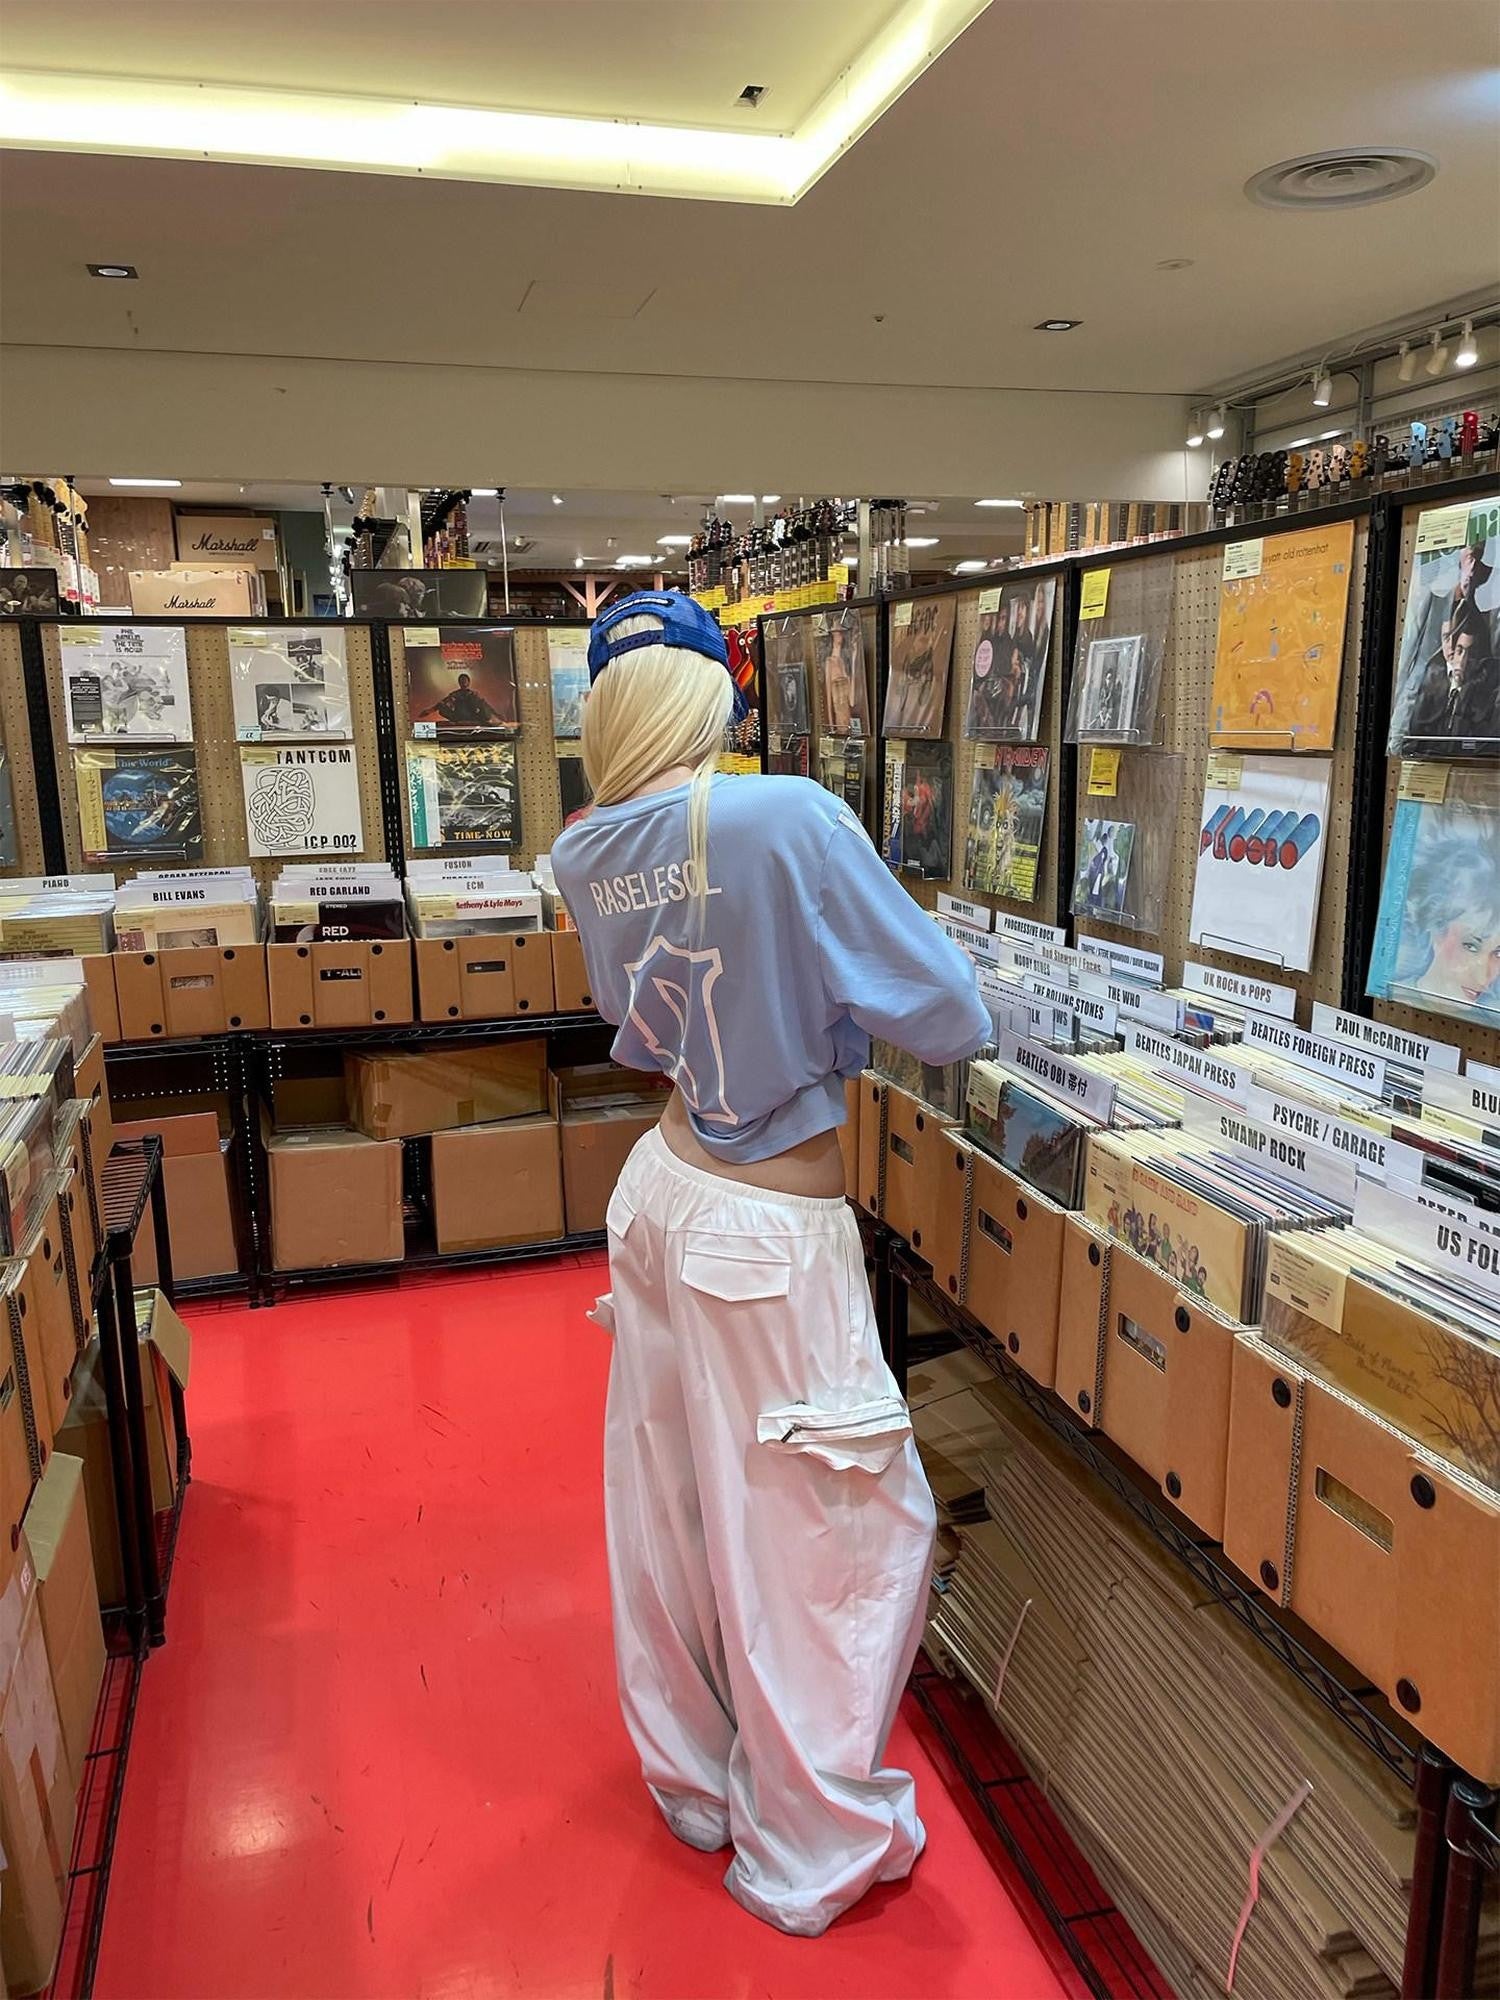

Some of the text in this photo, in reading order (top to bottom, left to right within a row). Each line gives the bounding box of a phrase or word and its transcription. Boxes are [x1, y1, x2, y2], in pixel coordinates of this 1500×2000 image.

[192, 533, 259, 551] Marshall
[1283, 548, 1295, 560] old
[164, 595, 216, 608] Marshall
[139, 758, 169, 767] World
[304, 834, 357, 850] ICP 002
[444, 860, 472, 869] FUSION
[42, 879, 69, 888] PIANO
[310, 886, 370, 896] RED GARLAND
[466, 881, 484, 890] ECM
[153, 890, 205, 901] BILL EVANS
[504, 899, 523, 907] Mays
[962, 903, 974, 917] ROCK
[322, 926, 349, 937] RED
[1004, 917, 1055, 941] PROGRESSIVE ROCK
[1014, 952, 1033, 970] MOODY
[1054, 949, 1077, 967] Stewart
[1203, 971, 1272, 1003] UK ROCK & POPS
[1033, 983, 1045, 997] THE
[1046, 988, 1074, 1008] ROLLING
[1073, 999, 1104, 1021] STONES
[1107, 985, 1140, 1009] THE WHO
[1335, 1016, 1430, 1062] PAUL McCARTNEY
[1251, 1021, 1375, 1080] BEATLES FOREIGN PRESS
[1135, 1032, 1237, 1090] BEATLES JAPAN PRESS
[1016, 1046, 1088, 1098] BEATLES OBI 帯付
[1472, 1088, 1500, 1115] BLU
[1273, 1103, 1320, 1141] PSYCHE
[1322, 1123, 1330, 1142] /
[1332, 1127, 1386, 1167] GARAGE
[1220, 1116, 1306, 1173] SWAMP ROCK
[1437, 1224, 1462, 1257] US
